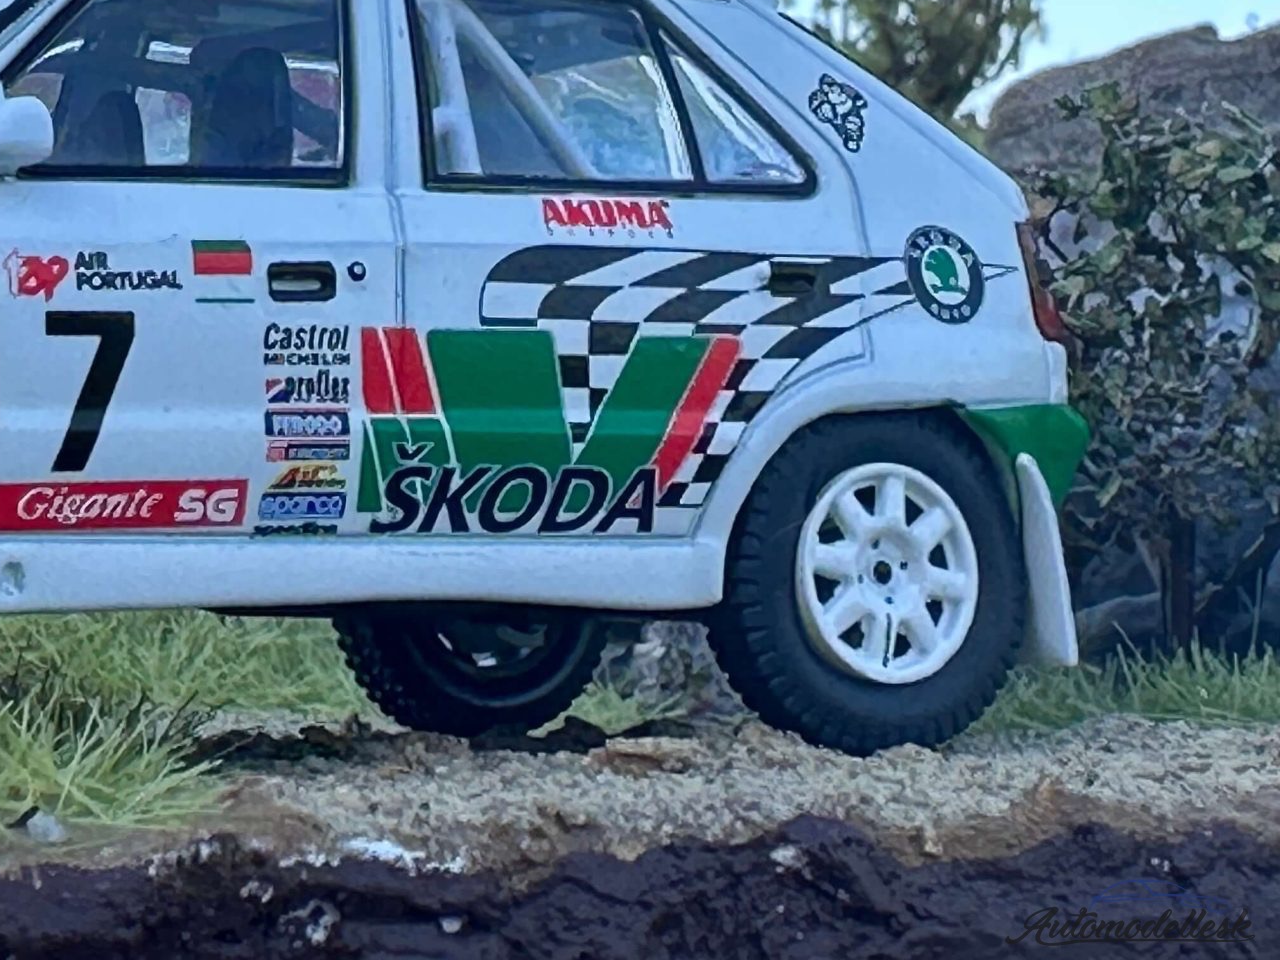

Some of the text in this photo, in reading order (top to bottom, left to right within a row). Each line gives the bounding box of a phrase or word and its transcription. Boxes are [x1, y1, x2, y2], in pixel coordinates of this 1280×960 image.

[74, 251, 110, 271] AIR
[76, 270, 183, 291] PORTUGAL
[263, 322, 349, 351] Castrol
[45, 311, 135, 472] 7
[16, 486, 164, 525] Gigante
[173, 488, 240, 523] SG
[370, 442, 657, 535] ŠKODA
